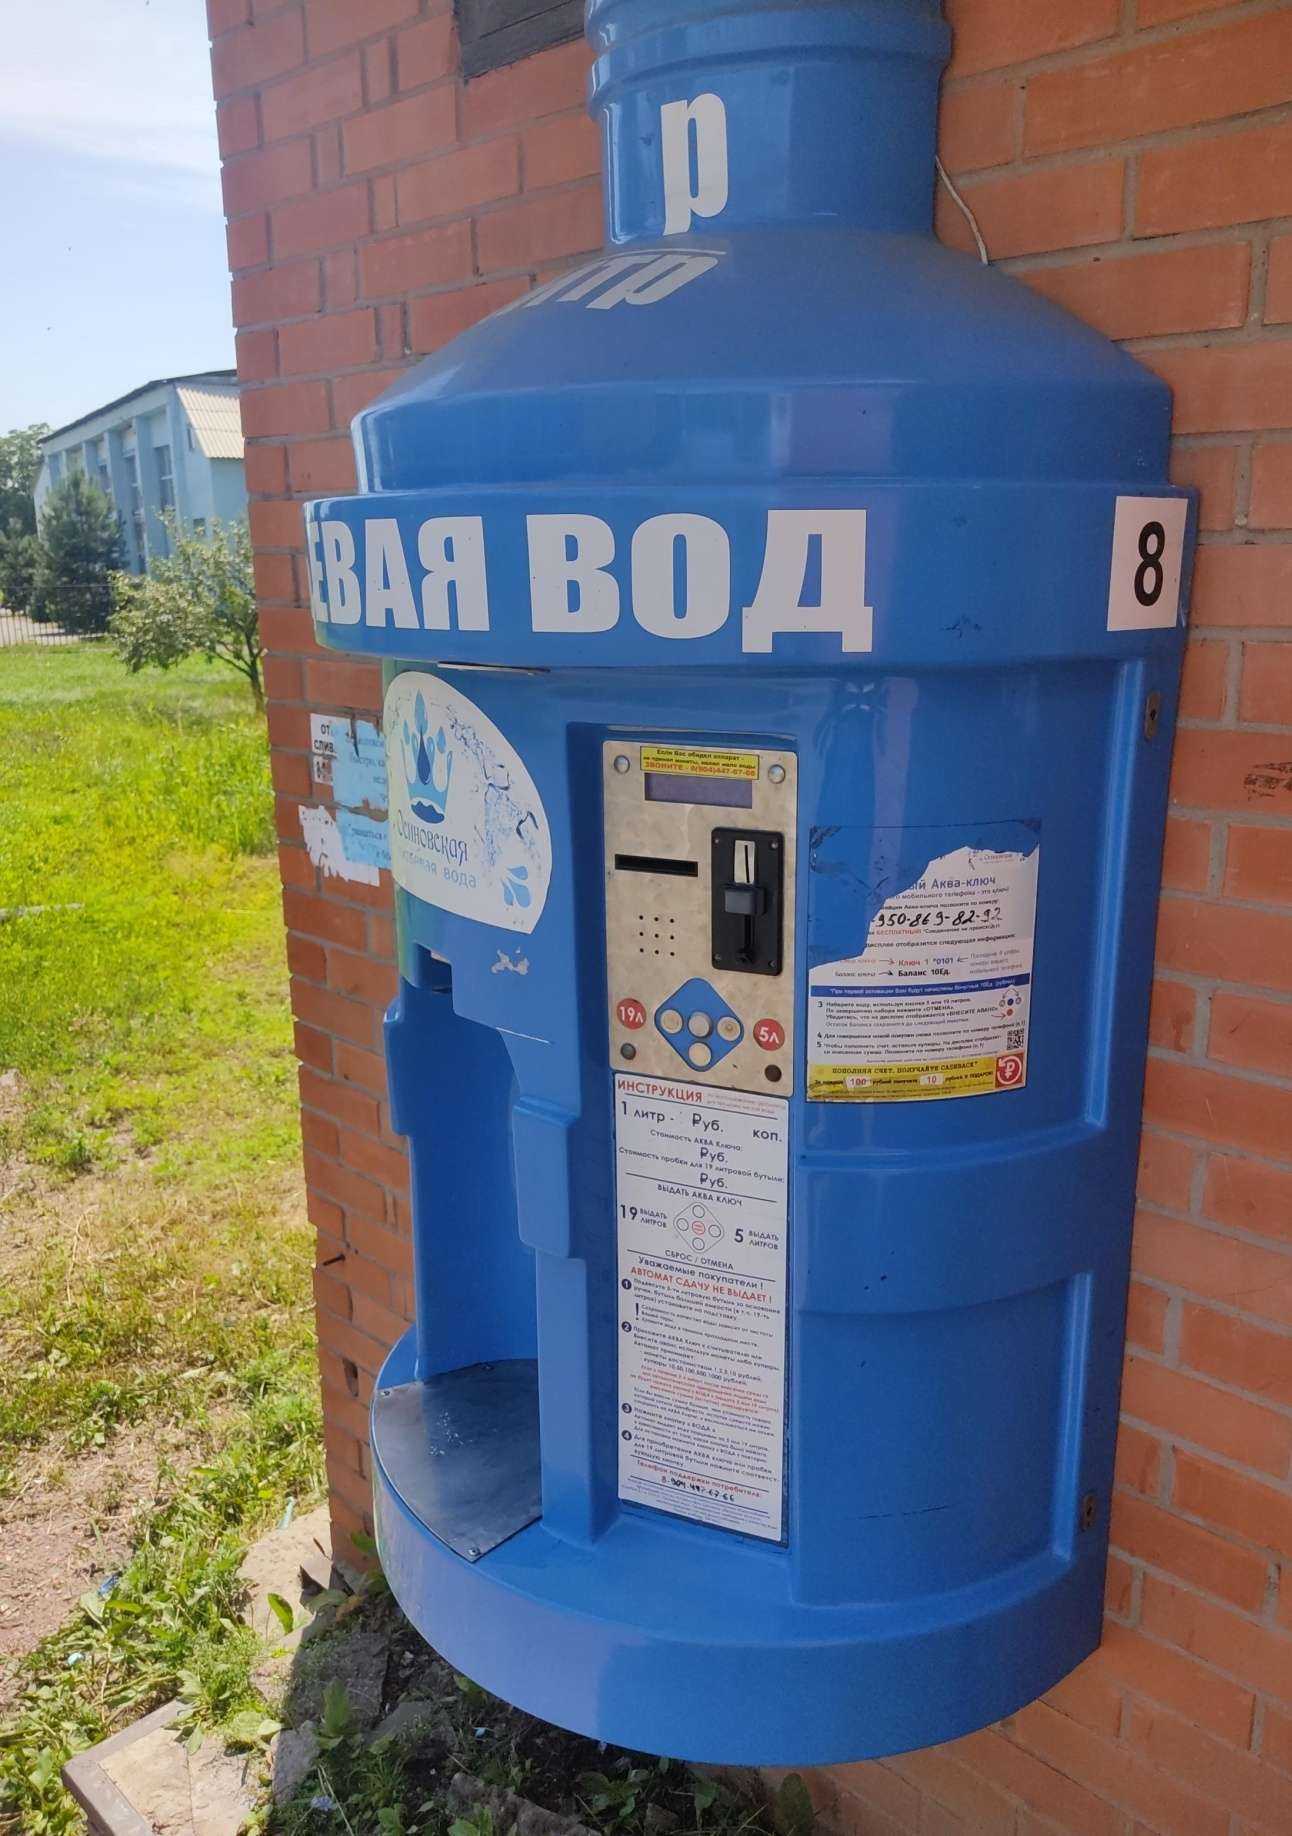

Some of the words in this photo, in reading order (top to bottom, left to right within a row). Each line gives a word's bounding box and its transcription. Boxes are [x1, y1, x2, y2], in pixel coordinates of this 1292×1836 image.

[1134, 521, 1165, 606] 8
[526, 509, 873, 653] ВОД
[931, 876, 996, 890] Аква-ключ
[898, 969, 928, 977] Баланс
[927, 1075, 937, 1084] 10
[617, 1079, 703, 1103] ИНСТРУКЦИЯ
[621, 1100, 627, 1115] 1
[634, 1109, 665, 1124] литр
[650, 1128, 692, 1143] Стоимость
[694, 1136, 714, 1147] АКВА
[618, 1146, 659, 1160] Стоимость
[657, 1183, 690, 1197] ВЫДАТЬ
[692, 1191, 715, 1202] АКВА
[716, 1195, 743, 1208] КЛЮЧ
[620, 1204, 638, 1220] 19
[639, 1207, 668, 1220] ВЫДАТЬ
[639, 1217, 667, 1229] ЛИТРОВ
[734, 1228, 744, 1243] 5
[748, 1230, 780, 1242] ВЫДАТЬ
[748, 1239, 779, 1250] ЛИТРОВ
[664, 1249, 693, 1263] СБРОС
[700, 1256, 735, 1271] ОТМЕНА
[638, 1256, 696, 1277] Уважаемые
[698, 1271, 758, 1289] покупатели
[630, 1266, 674, 1283] АВТОМАТ
[675, 1276, 710, 1291] СДАЧУ
[712, 1285, 726, 1296] НЕ
[727, 1288, 767, 1303] ВЫДАЕТ
